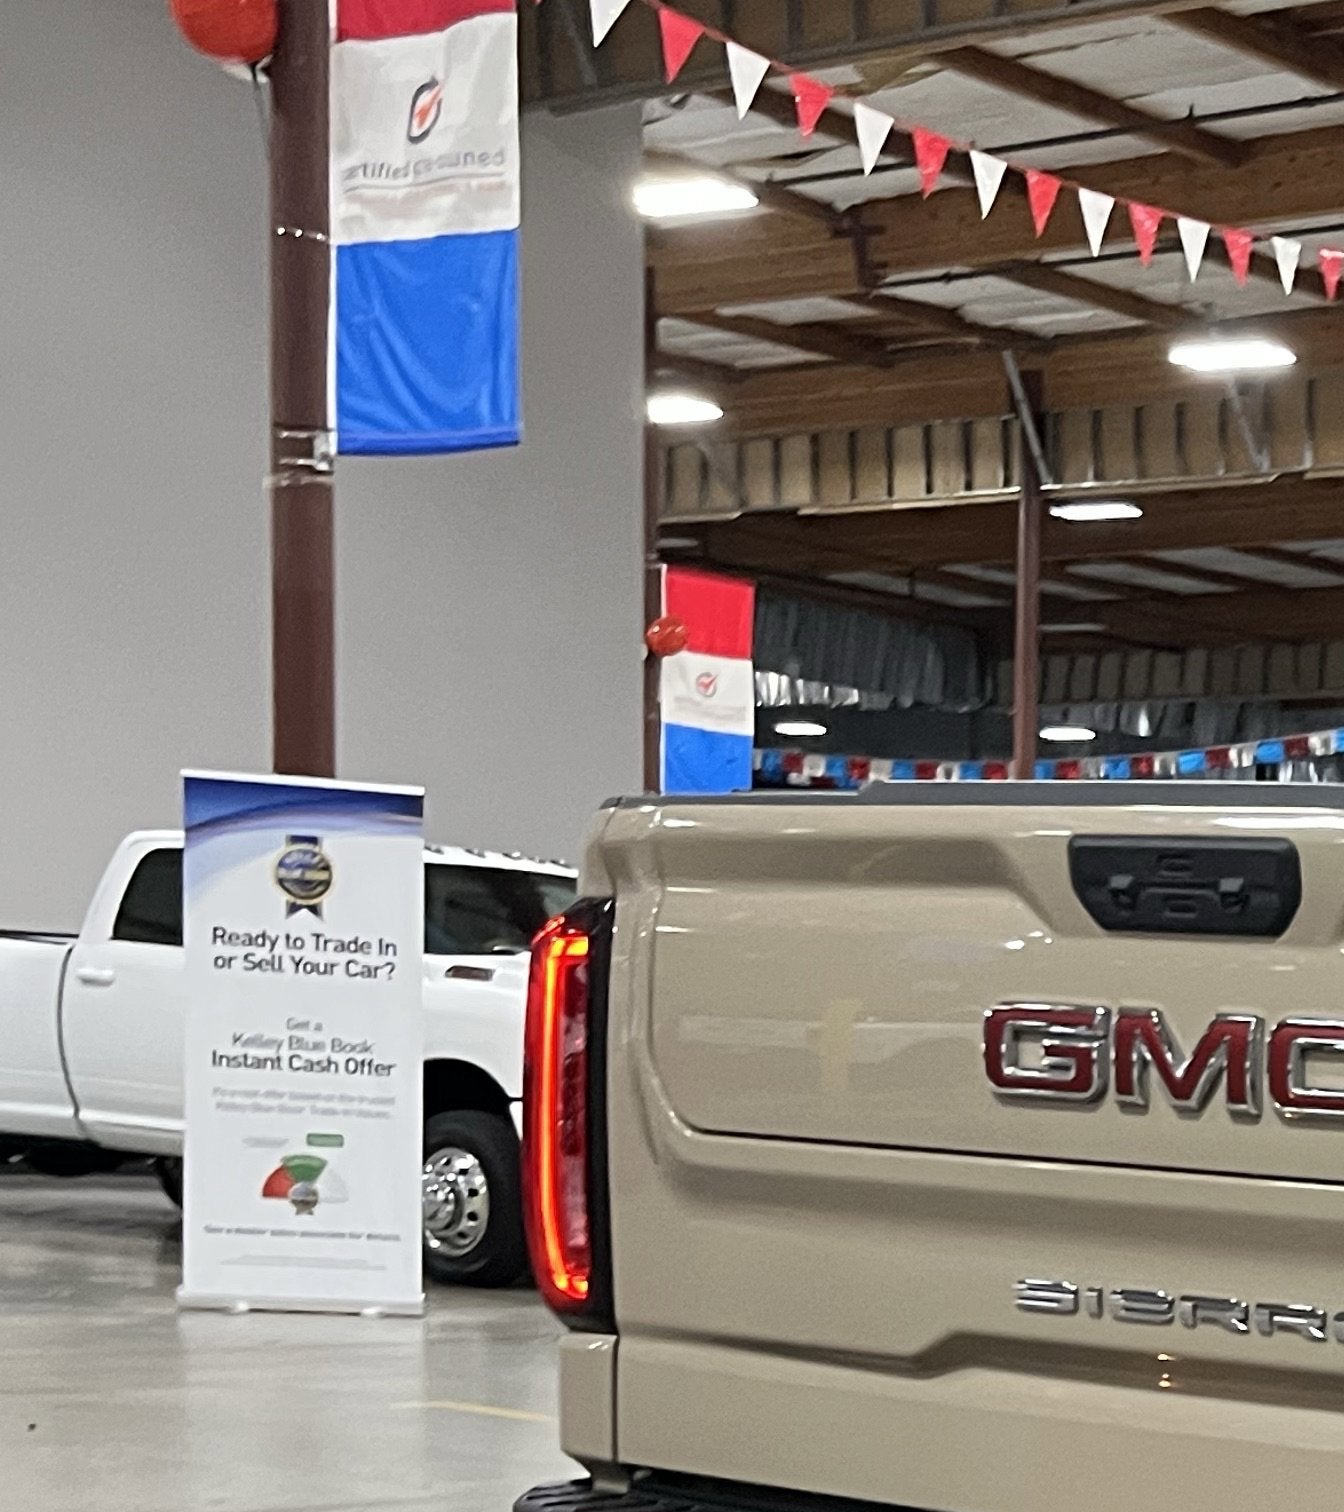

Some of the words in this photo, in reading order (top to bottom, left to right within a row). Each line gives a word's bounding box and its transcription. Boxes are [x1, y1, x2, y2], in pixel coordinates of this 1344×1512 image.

[212, 926, 279, 952] Ready
[285, 932, 305, 950] to
[311, 932, 373, 955] Trade
[378, 938, 398, 957] In
[213, 954, 238, 969] or
[243, 952, 284, 973] Sell
[290, 956, 339, 976] Your
[345, 960, 396, 981] Car?
[212, 1050, 284, 1071] Instant
[288, 1054, 339, 1075] Cash
[344, 1057, 397, 1077] Offer
